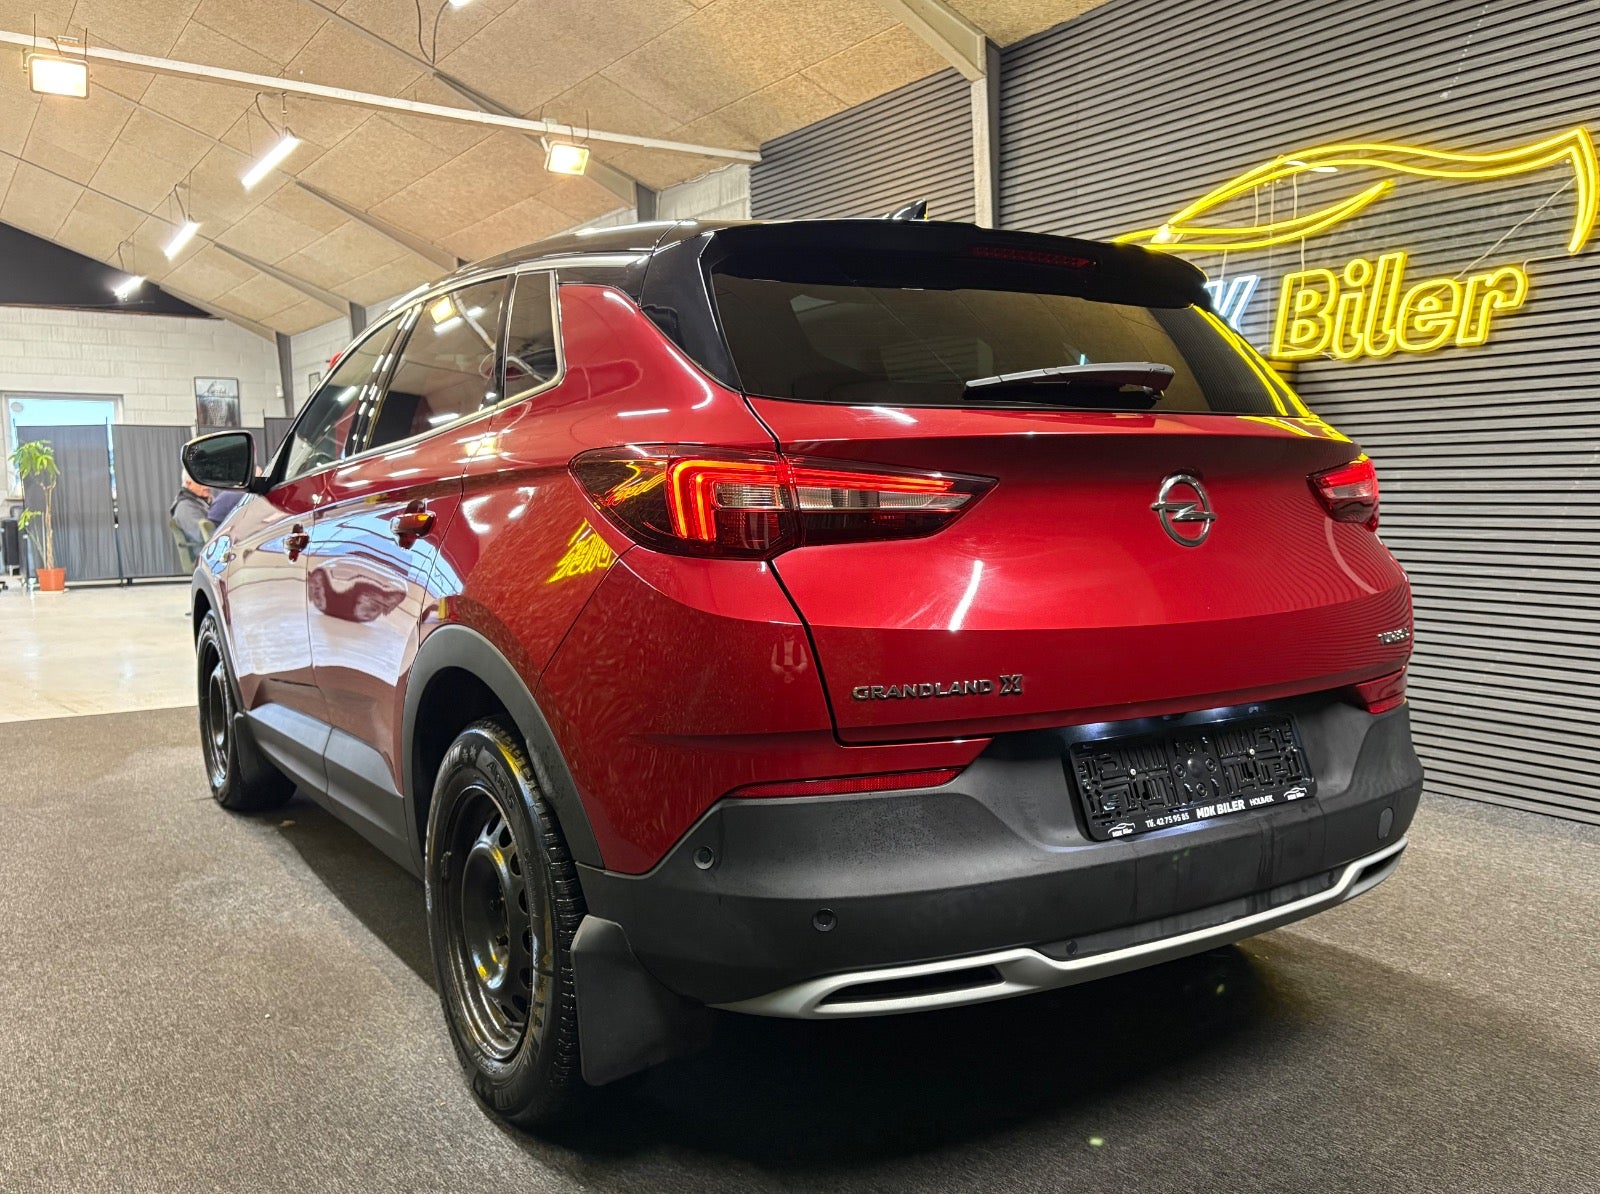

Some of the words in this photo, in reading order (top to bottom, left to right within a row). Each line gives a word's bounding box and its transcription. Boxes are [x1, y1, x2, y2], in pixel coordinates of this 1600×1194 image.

[1271, 251, 1529, 359] Biler
[852, 679, 994, 700] GRANDLAND
[998, 674, 1023, 695] X
[1196, 804, 1217, 819] MDK
[1217, 799, 1246, 815] BILER
